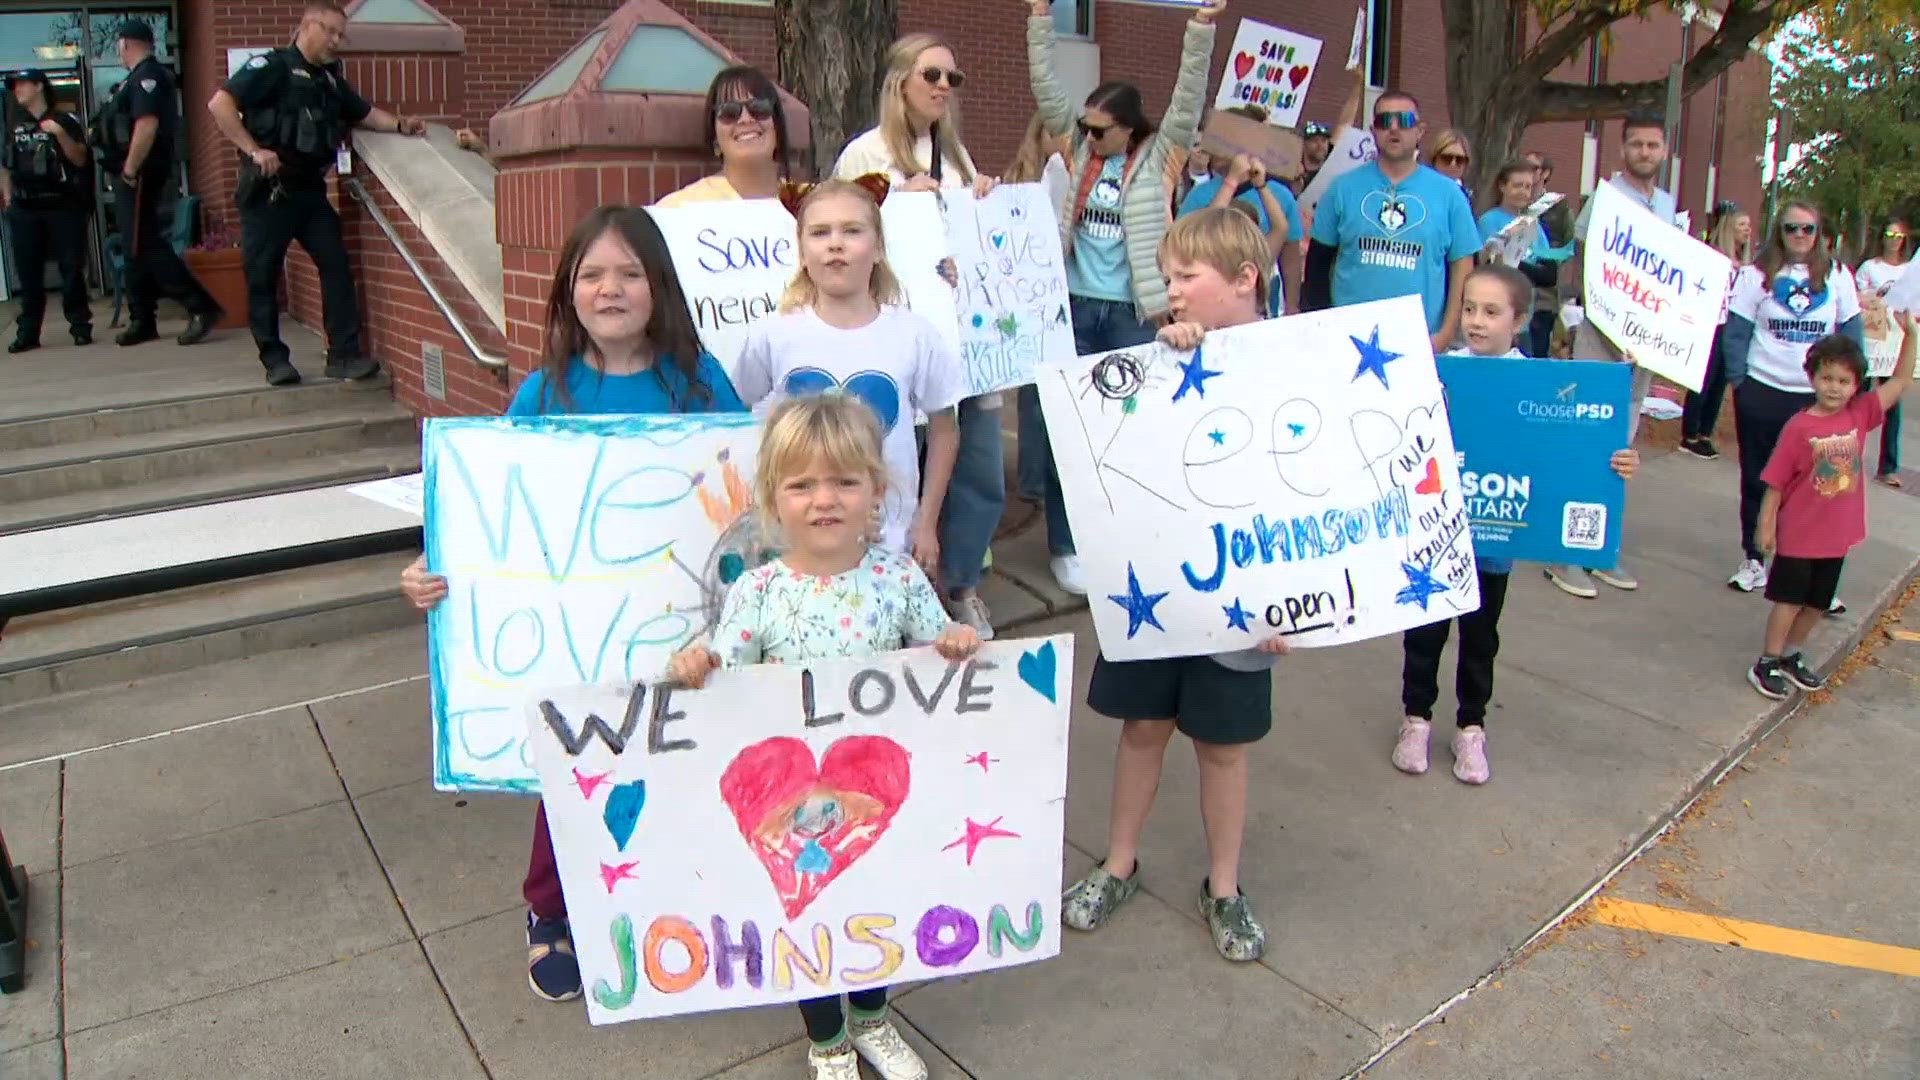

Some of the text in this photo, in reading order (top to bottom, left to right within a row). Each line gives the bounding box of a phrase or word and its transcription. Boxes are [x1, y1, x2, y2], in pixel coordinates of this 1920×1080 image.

[1256, 62, 1284, 85] OUR
[1259, 39, 1296, 64] SAVE
[1231, 81, 1298, 109] SCHOOLS!
[697, 228, 792, 273] Save
[1358, 237, 1422, 256] JOHNSON
[1361, 250, 1417, 271] STRONG
[1603, 215, 1684, 295] Johnson
[1603, 262, 1671, 314] Webber
[443, 432, 698, 584] We
[1180, 487, 1411, 593] Johnson
[1265, 567, 1356, 635] open!
[538, 680, 698, 757] WE
[802, 658, 999, 729] LOVE
[592, 902, 1044, 1011] JOHNSON
